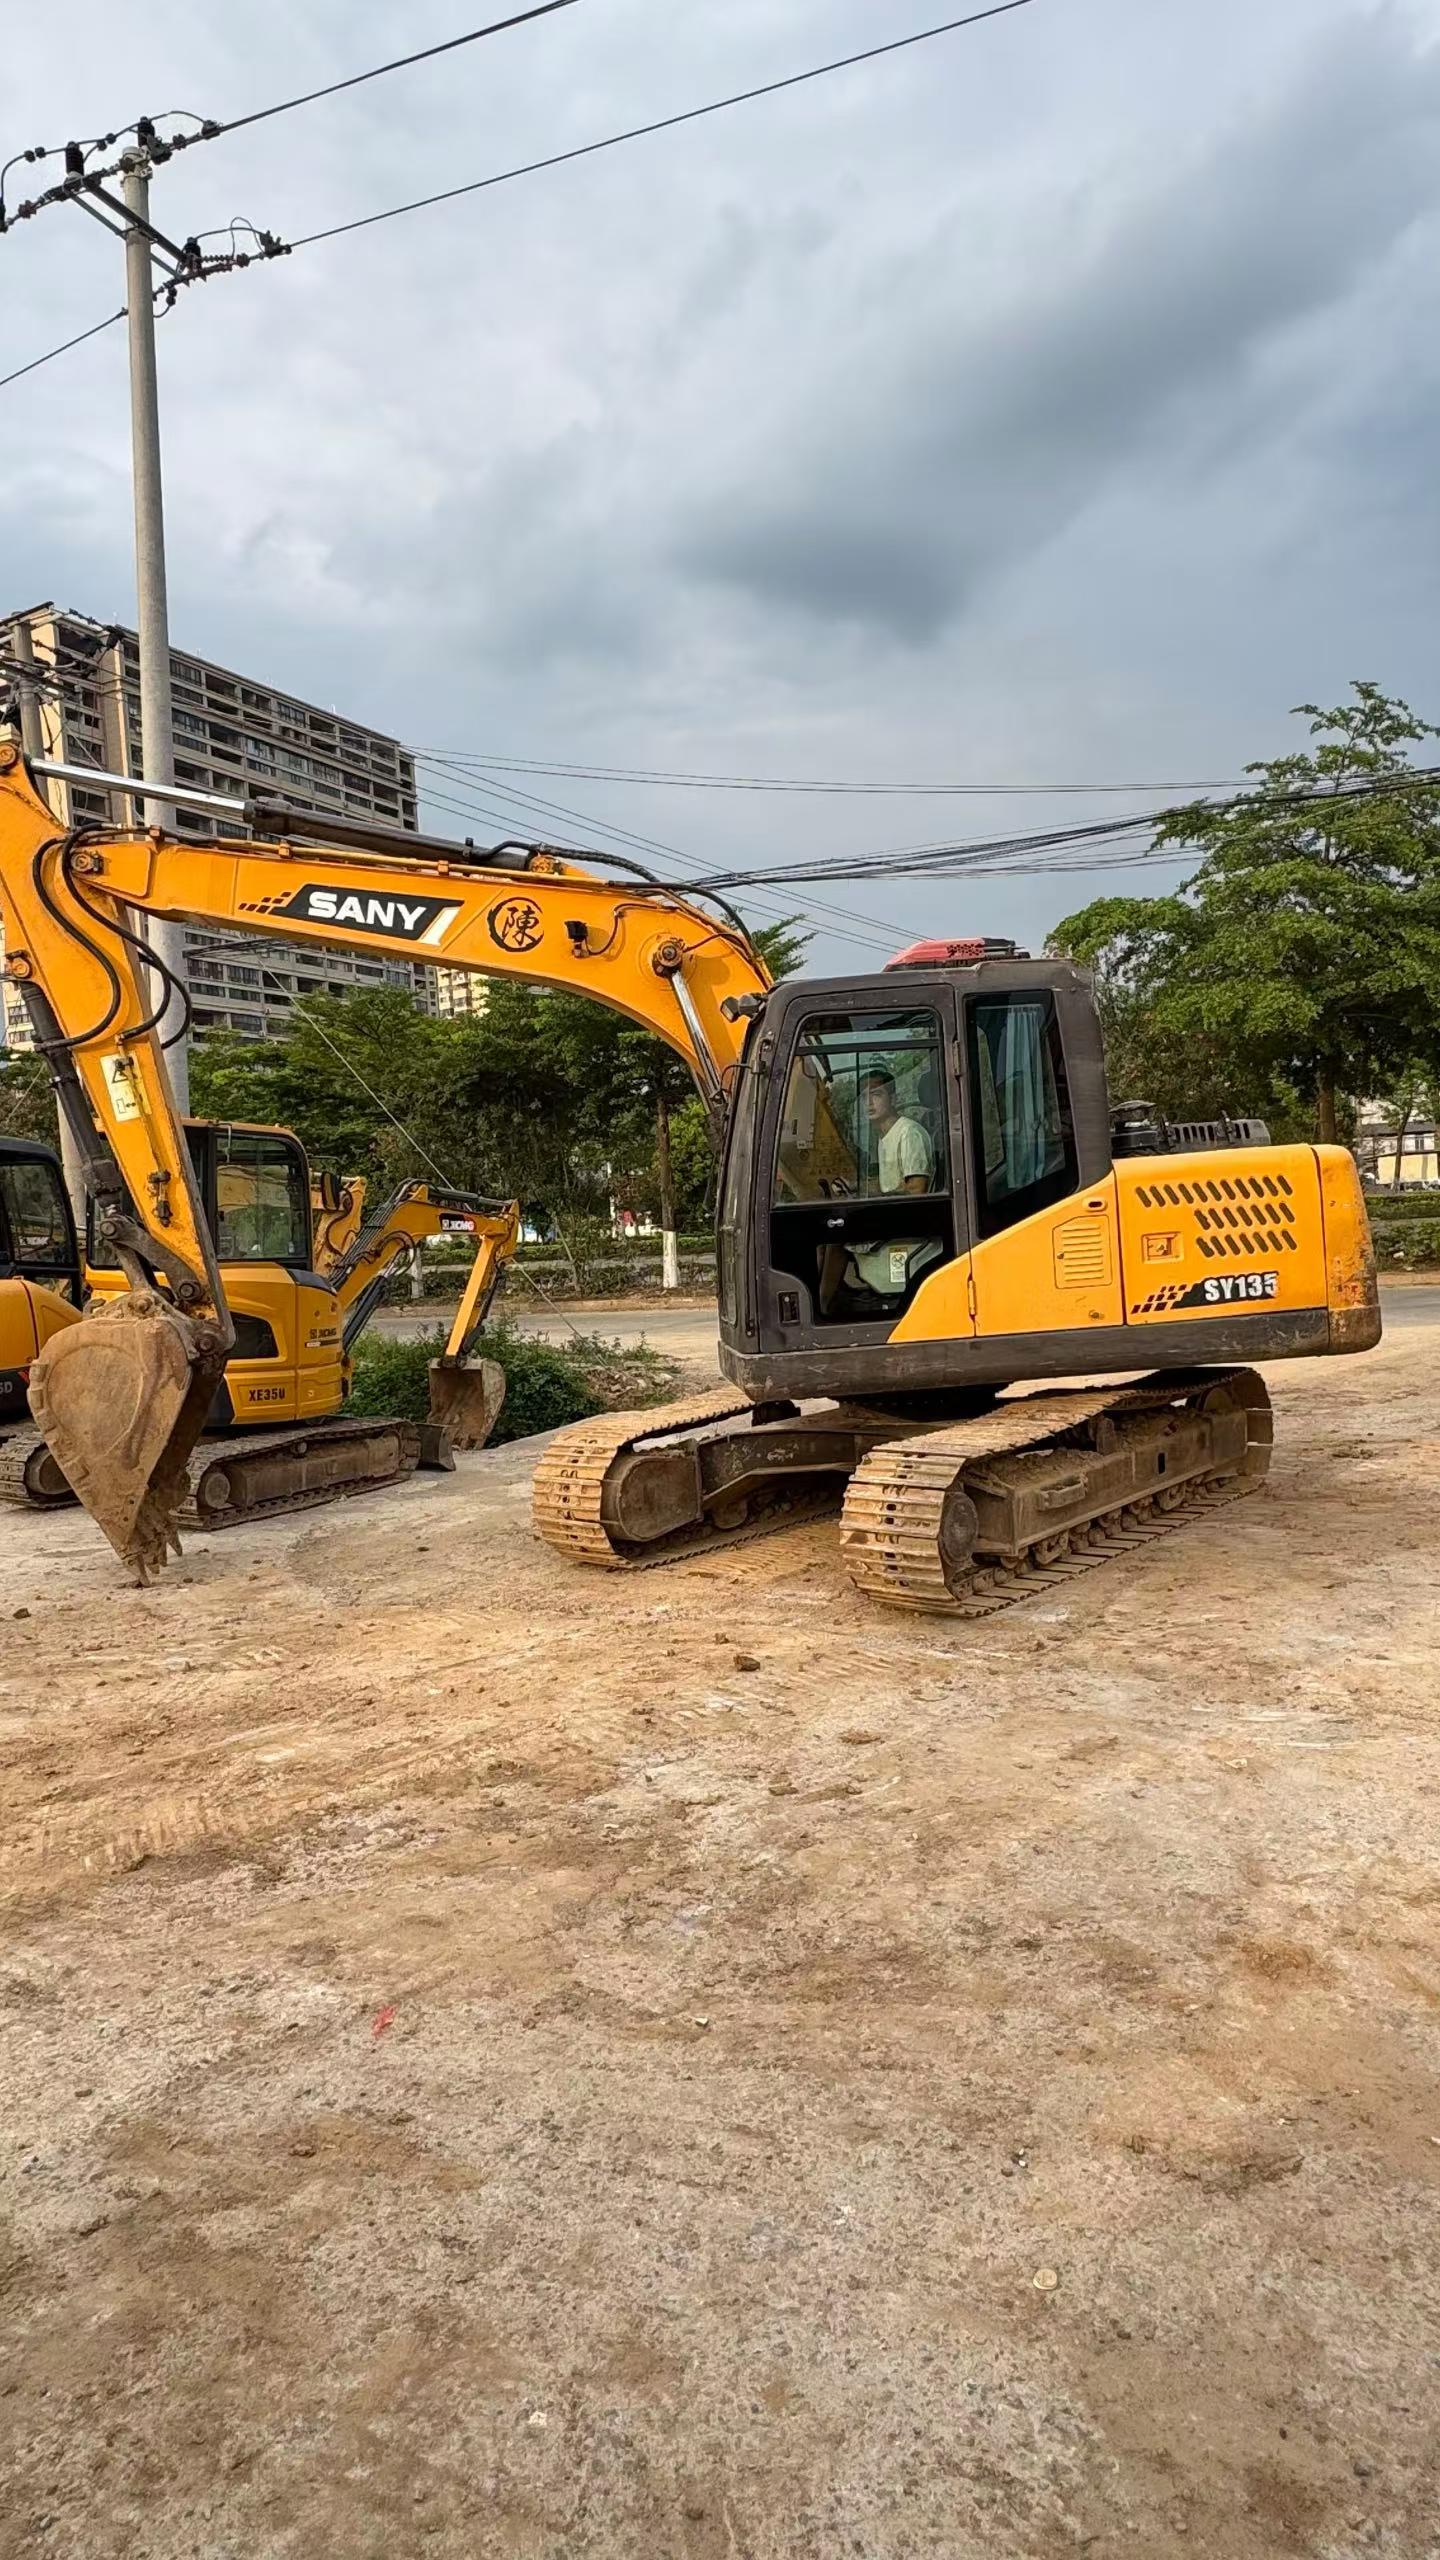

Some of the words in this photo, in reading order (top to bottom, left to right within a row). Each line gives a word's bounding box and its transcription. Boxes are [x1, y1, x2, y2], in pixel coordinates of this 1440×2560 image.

[308, 891, 426, 930] SANY
[502, 905, 540, 946] 陳
[1204, 1272, 1279, 1302] SY135
[248, 1388, 286, 1402] XE35U
